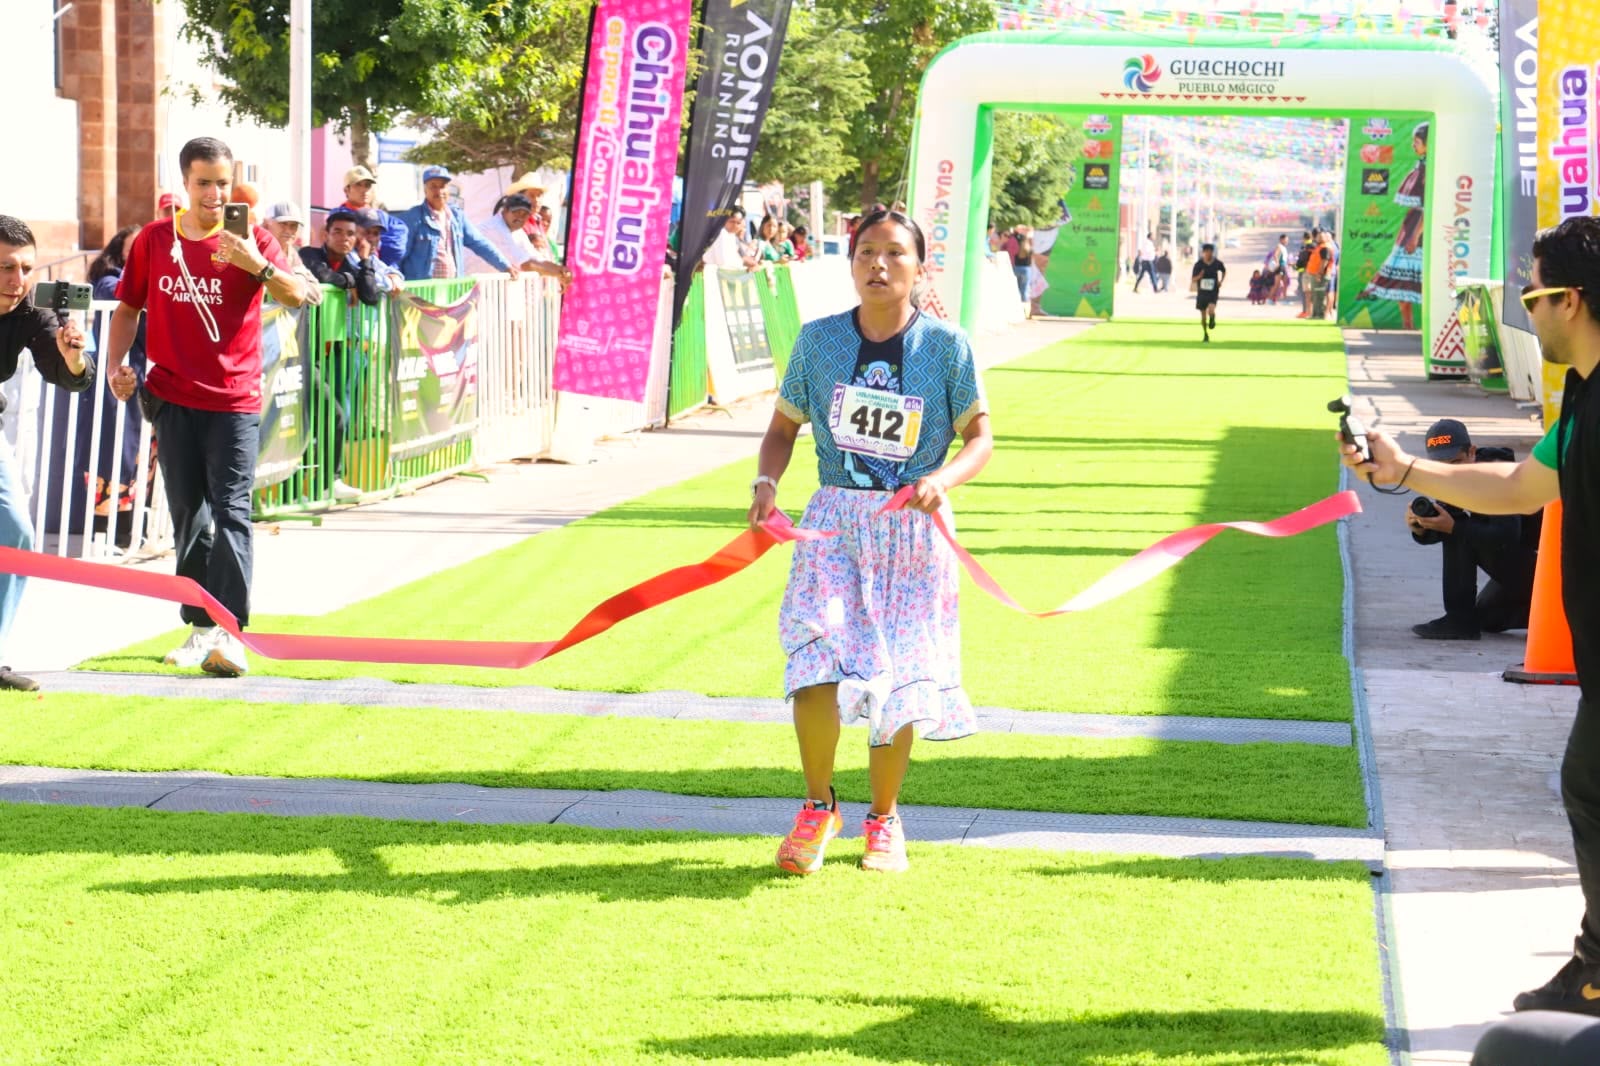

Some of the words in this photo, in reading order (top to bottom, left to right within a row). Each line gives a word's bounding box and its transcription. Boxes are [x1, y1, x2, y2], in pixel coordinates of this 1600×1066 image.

[607, 20, 623, 46] es
[598, 51, 620, 104] para
[711, 33, 740, 159] RUNNING
[725, 10, 773, 185] AONIJIE
[1179, 83, 1225, 93] PUEBLO
[599, 109, 617, 124] ti
[612, 25, 673, 271] Chihuahua
[583, 131, 615, 260] ¡Conócelo!
[933, 160, 954, 273] GUACHOCHI
[1453, 175, 1473, 276] GUACHOC
[159, 275, 222, 295] QAAR
[850, 405, 904, 442] 412
